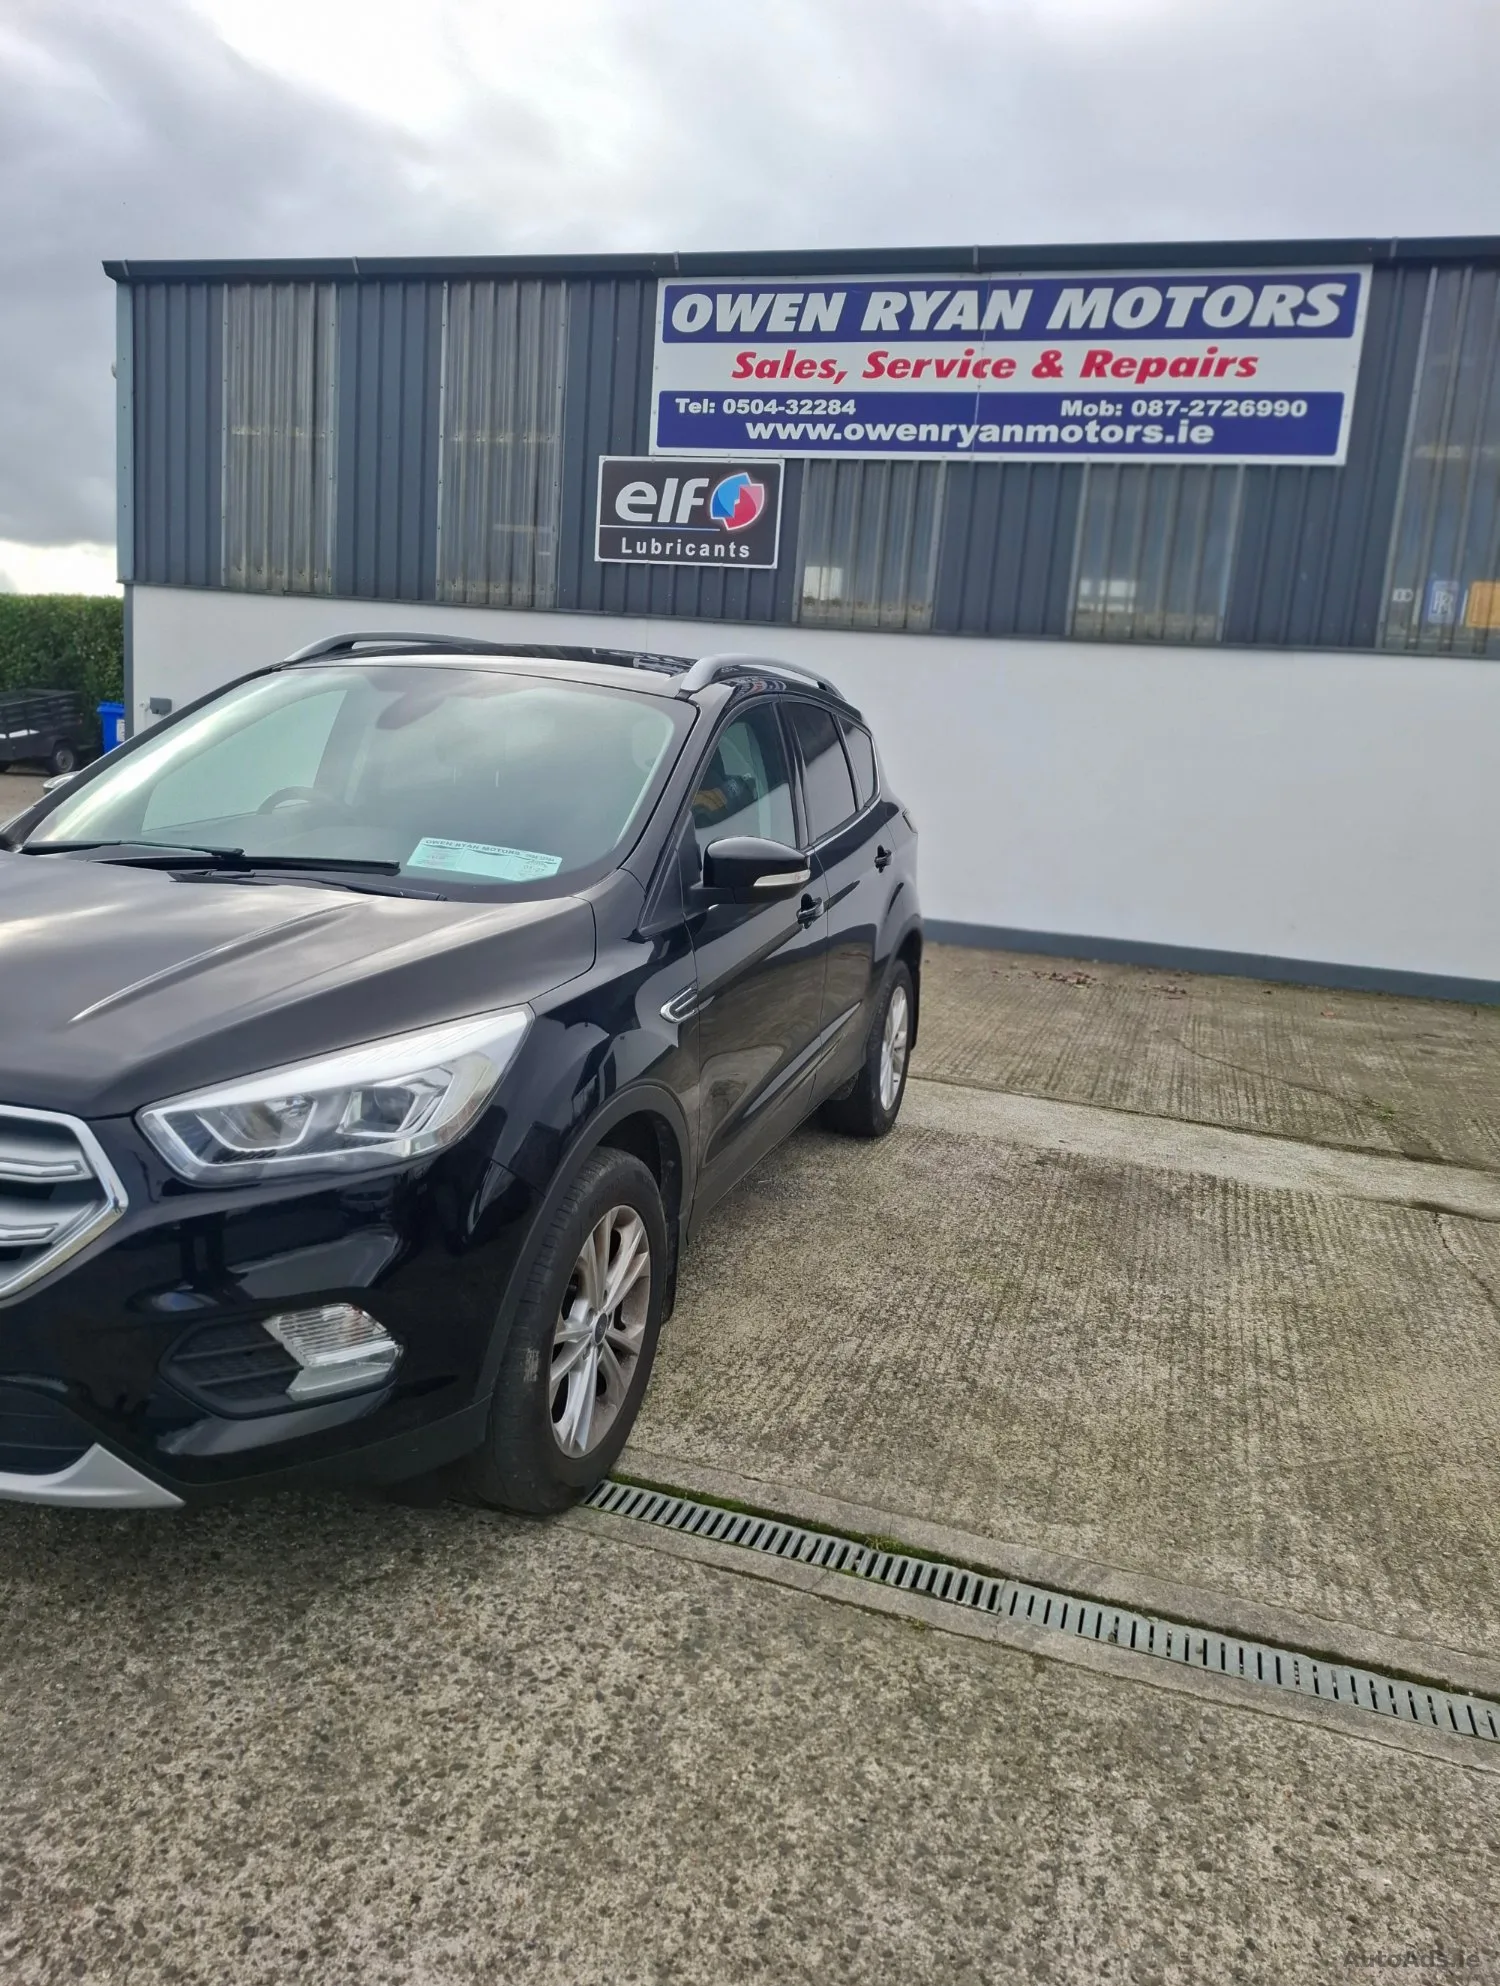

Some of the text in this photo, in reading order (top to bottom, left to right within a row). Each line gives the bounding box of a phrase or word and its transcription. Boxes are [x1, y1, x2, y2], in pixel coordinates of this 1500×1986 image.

[672, 283, 1347, 334] OWEN RYAN MOTORS
[731, 346, 1259, 384] Sales, Service & Repairs
[675, 398, 857, 416] Tel: 0504-32284
[1060, 400, 1308, 418] Mob: 087-2726990
[745, 419, 1214, 449] www.owenryanmotors.ie
[615, 478, 710, 524] elf
[620, 537, 751, 559] Lubricants
